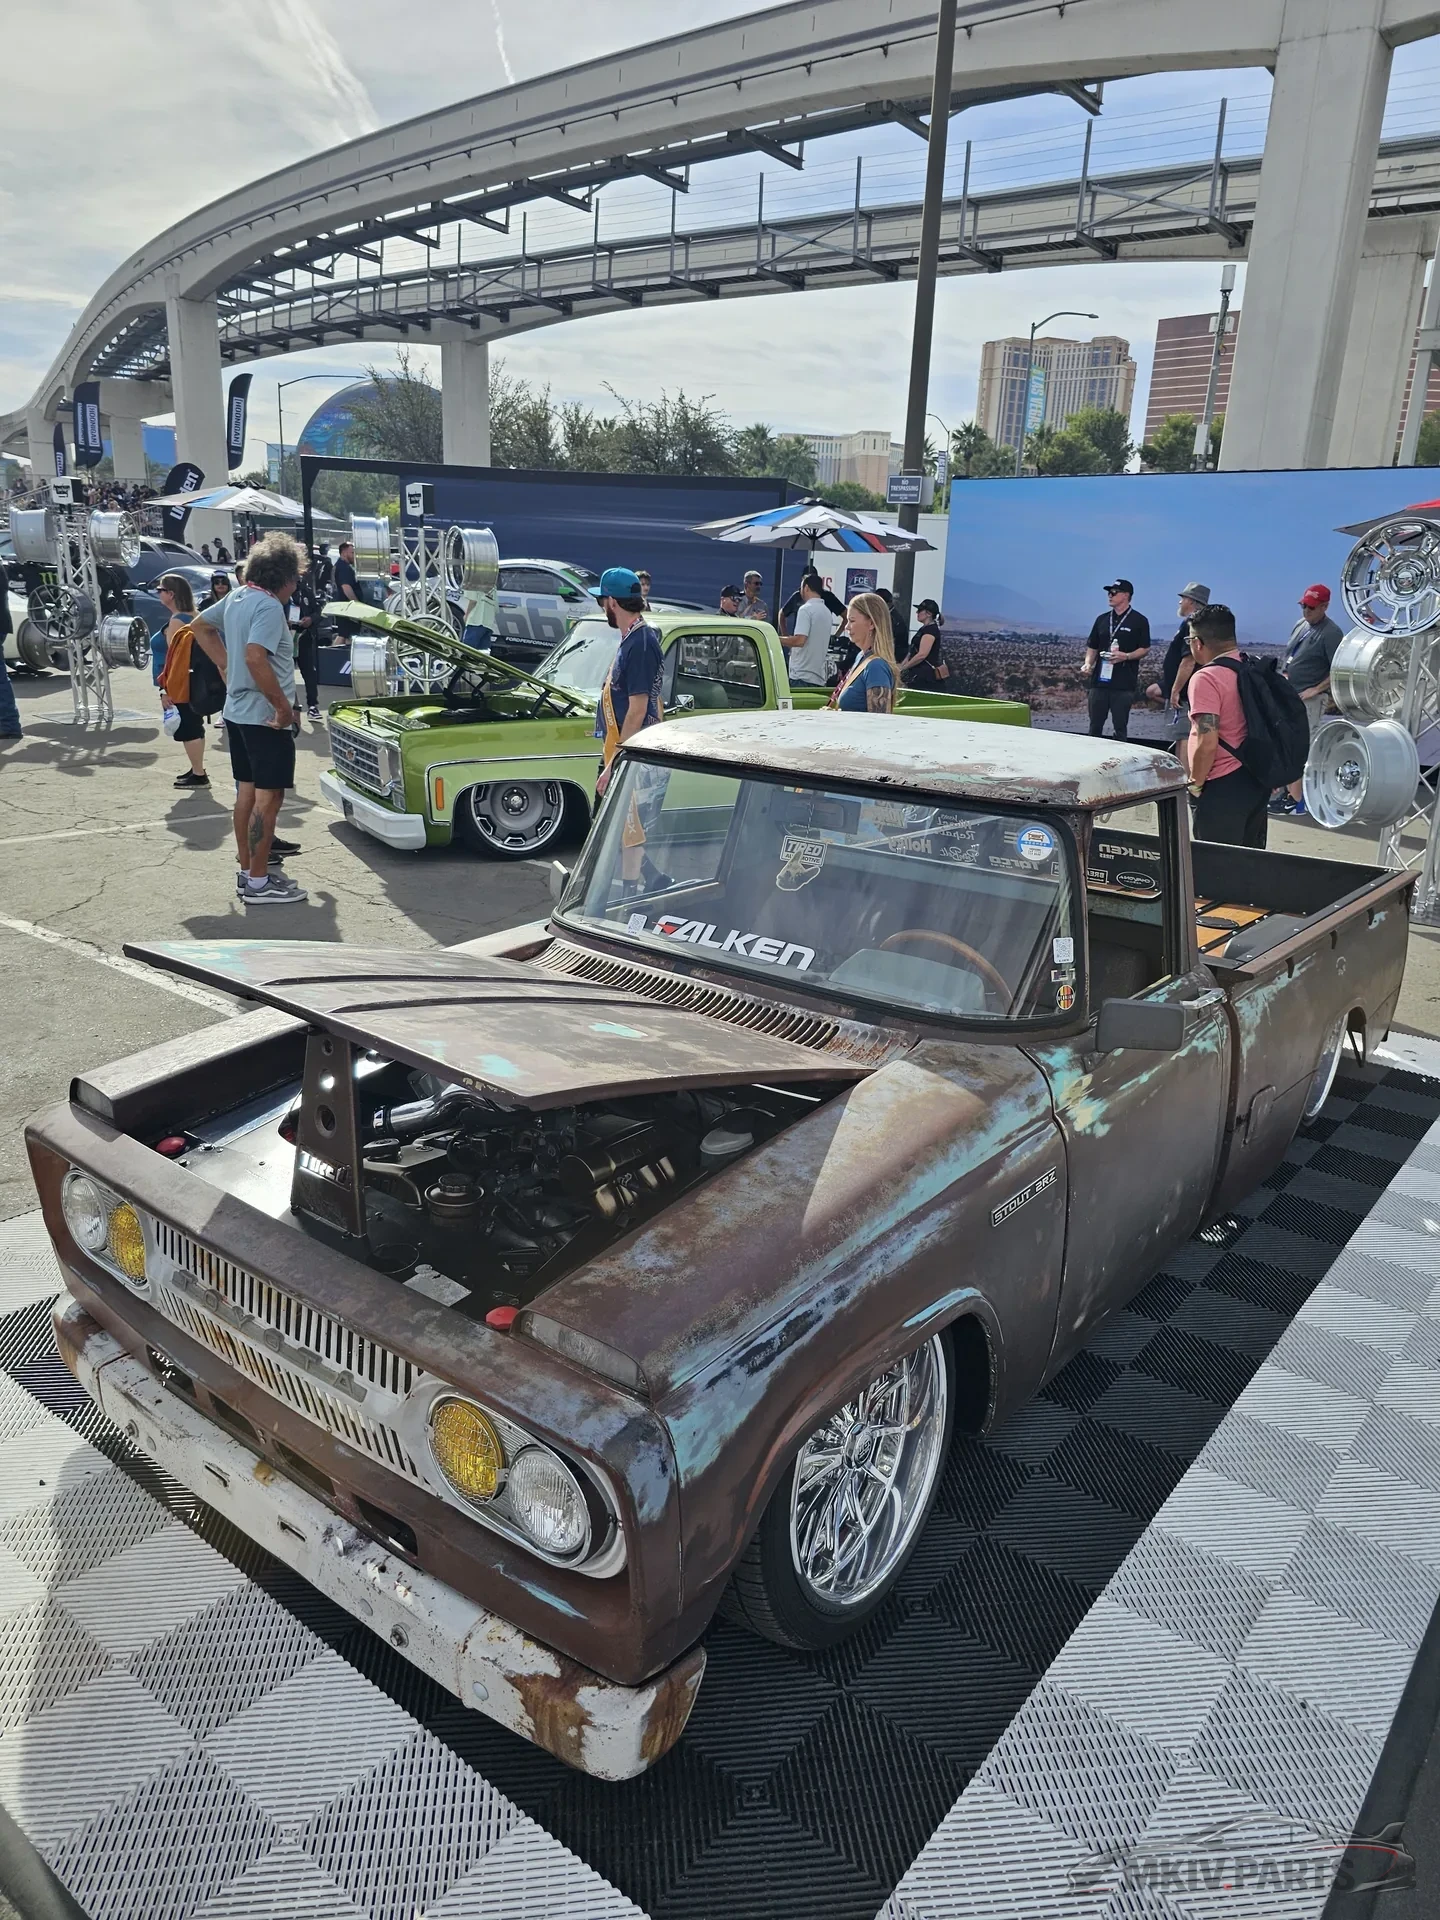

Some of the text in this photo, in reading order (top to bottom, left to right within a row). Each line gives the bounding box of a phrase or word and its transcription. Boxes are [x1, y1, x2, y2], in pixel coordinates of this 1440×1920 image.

[1026, 376, 1046, 430] LAS VEGAS
[170, 471, 200, 521] Uden
[853, 576, 869, 585] FCE
[651, 914, 816, 972] FALKEN
[994, 1170, 1057, 1223] STOUT 2RZ
[173, 1269, 355, 1397] TOYOTA
